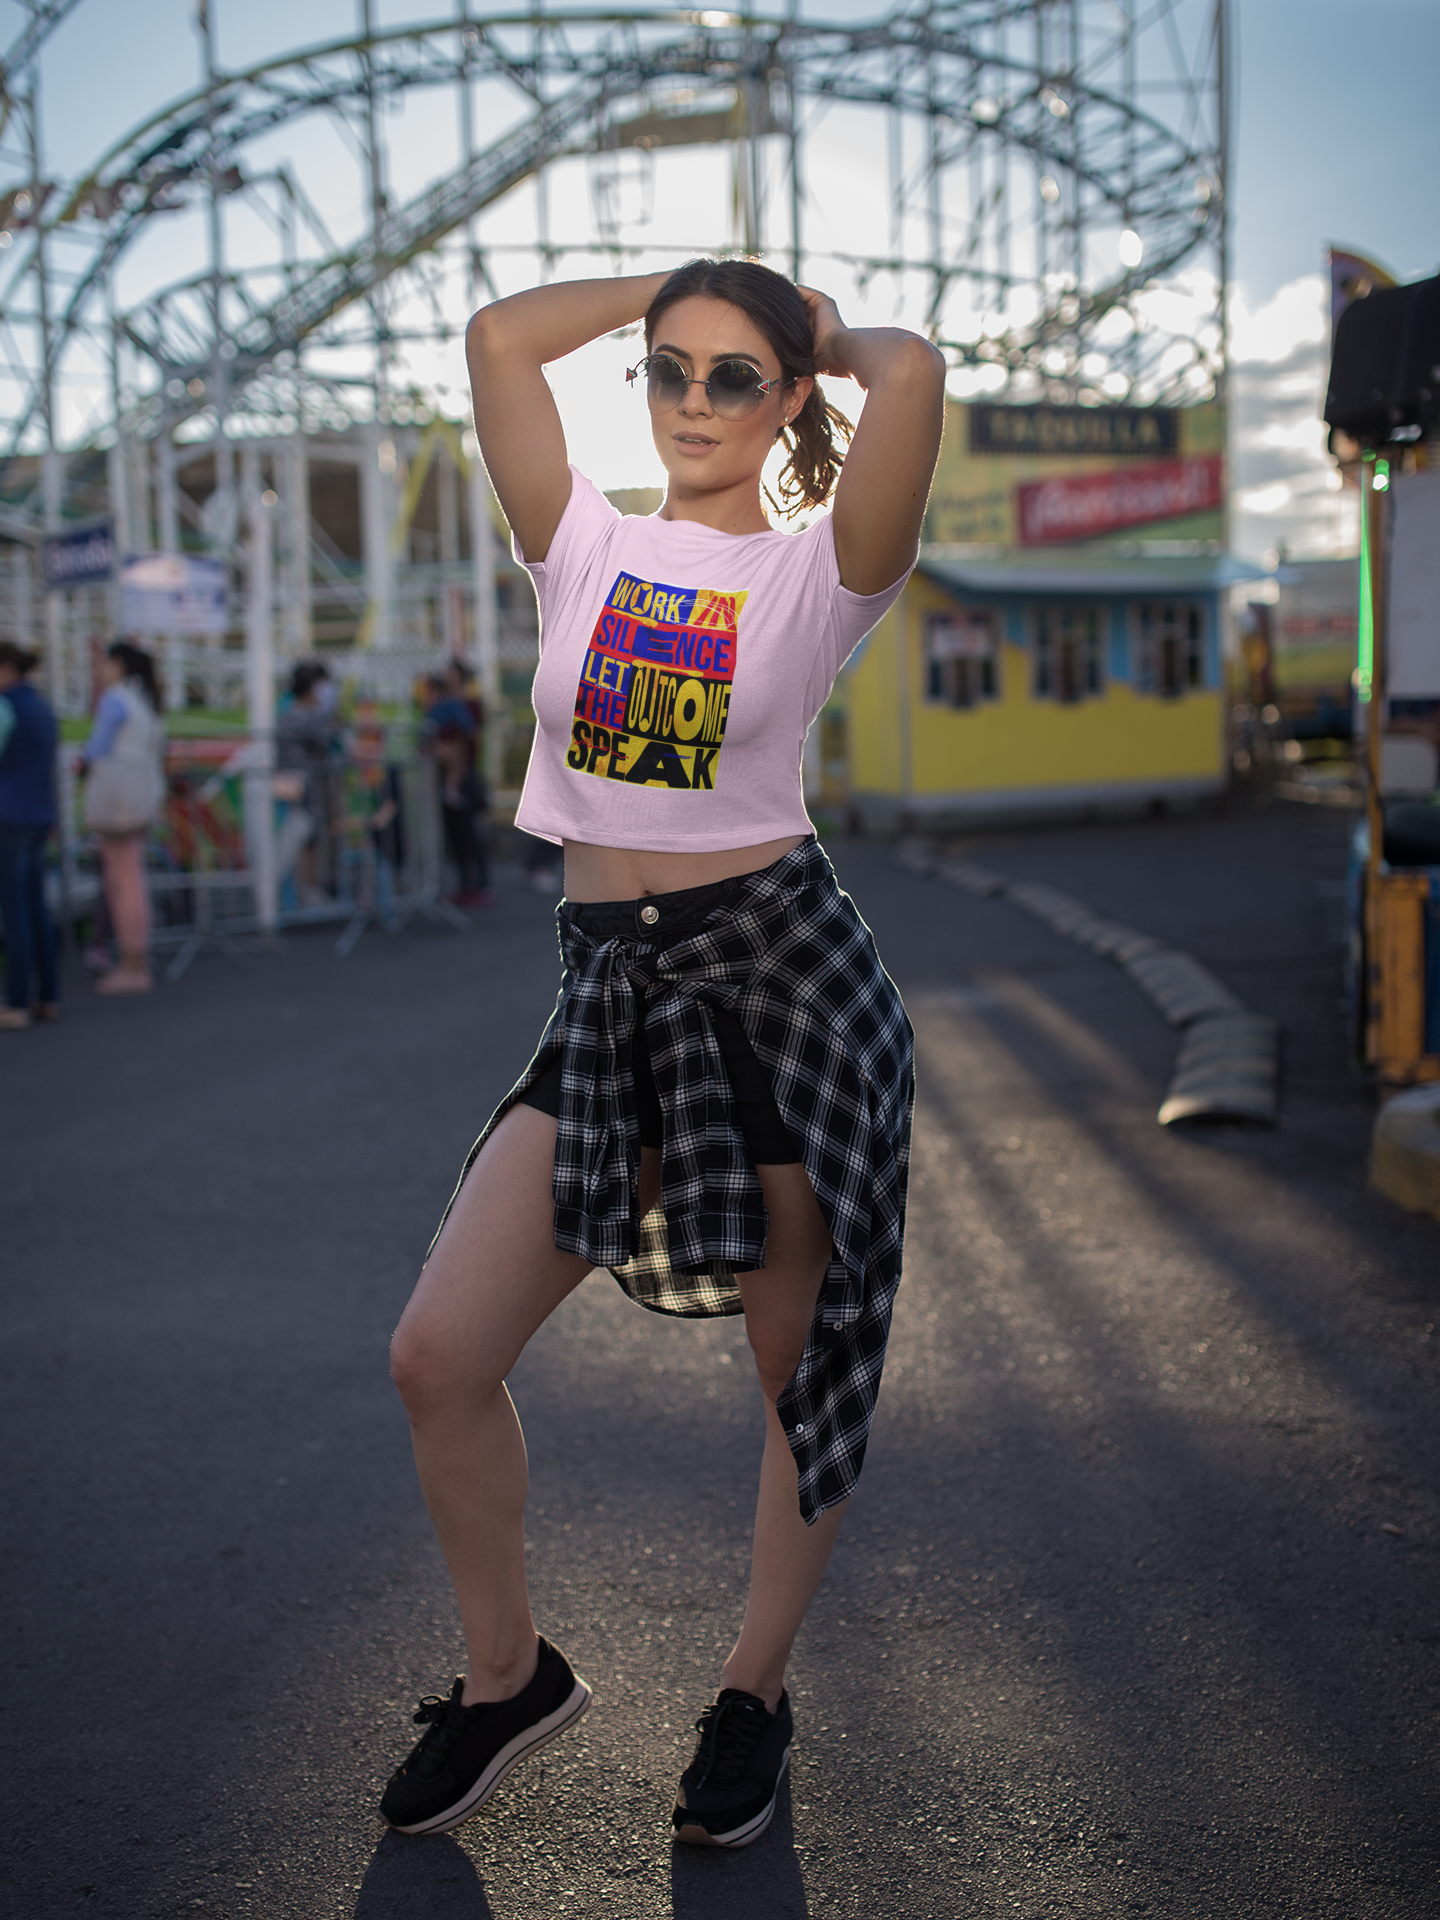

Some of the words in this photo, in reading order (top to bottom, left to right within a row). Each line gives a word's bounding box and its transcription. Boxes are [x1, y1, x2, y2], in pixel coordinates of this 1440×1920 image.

[611, 577, 686, 623] WORK
[692, 595, 738, 632] IN
[584, 651, 630, 691] LET
[597, 614, 731, 673] SILENCE
[579, 684, 624, 730] THE
[628, 667, 732, 743] OUTCOME
[567, 720, 718, 789] SPEAK
